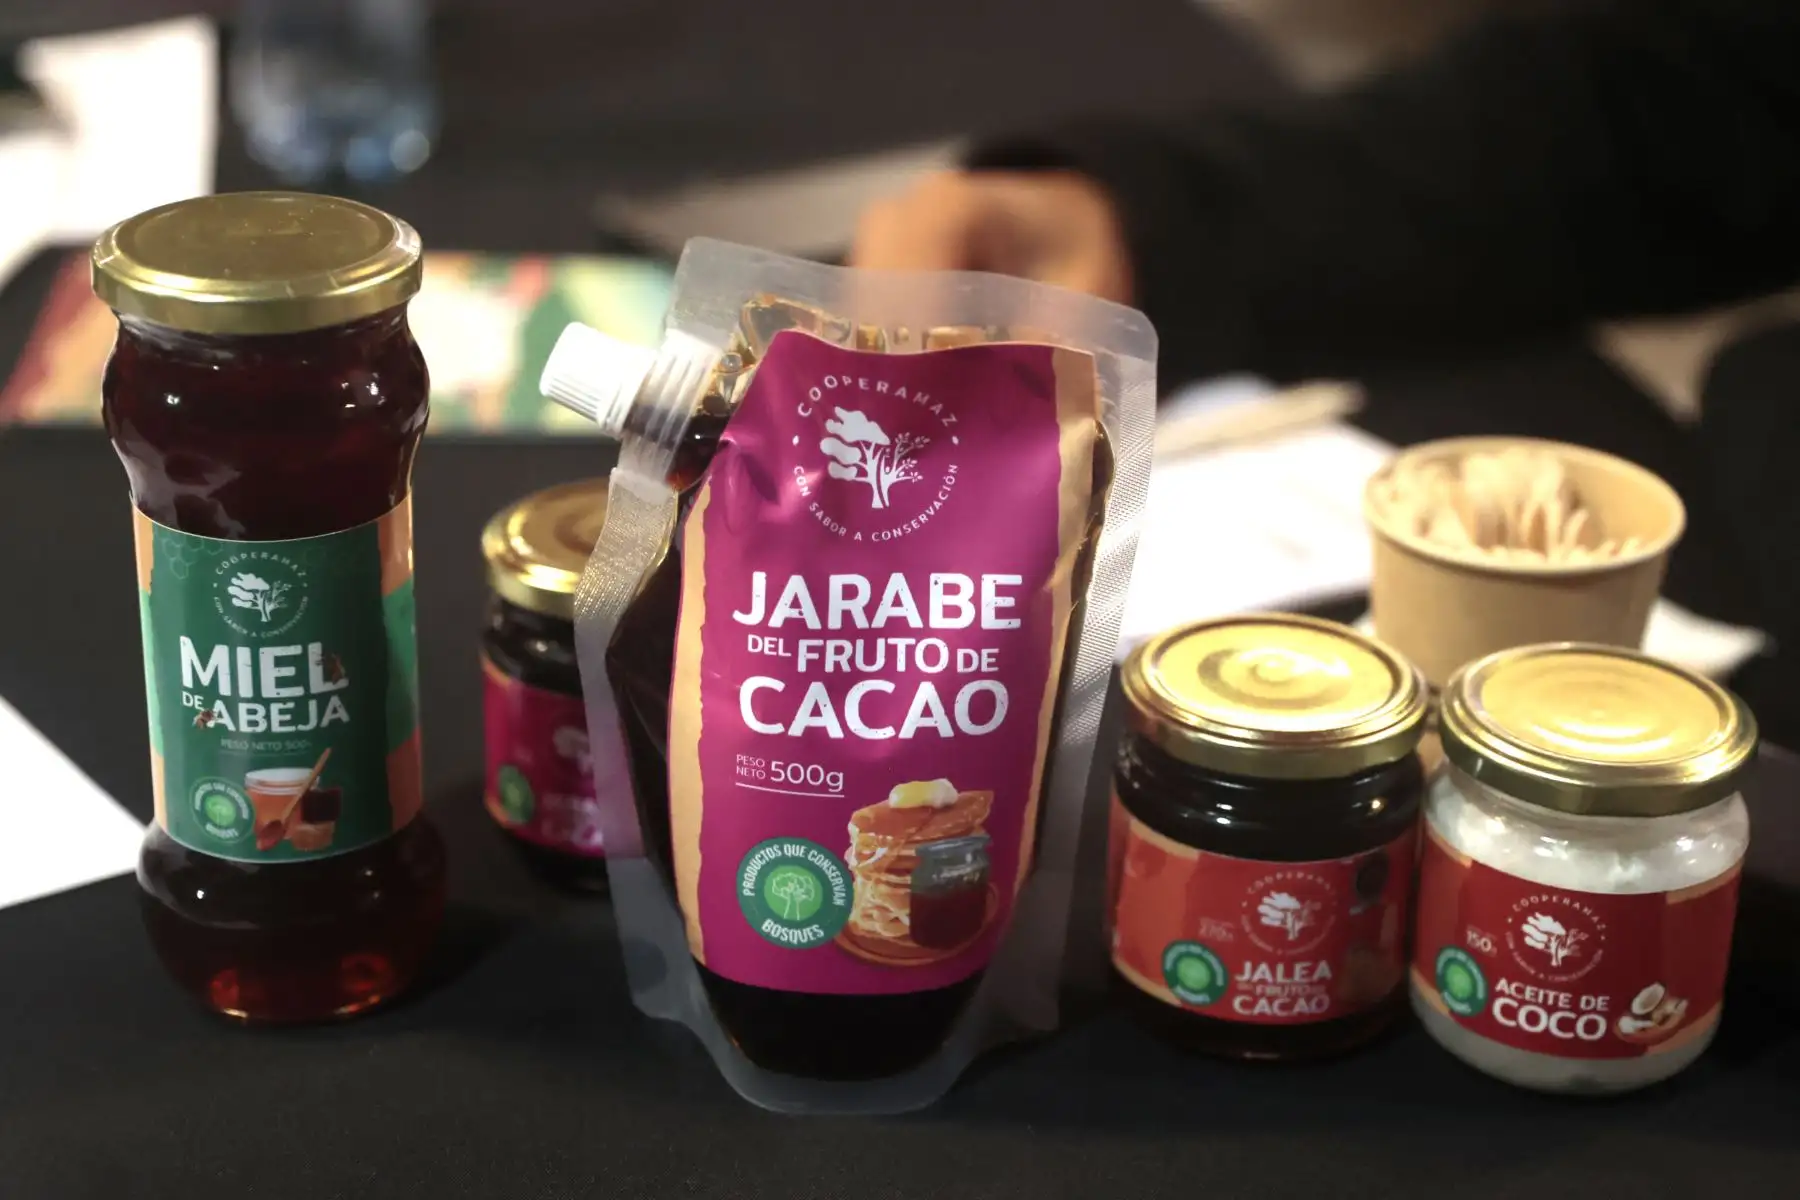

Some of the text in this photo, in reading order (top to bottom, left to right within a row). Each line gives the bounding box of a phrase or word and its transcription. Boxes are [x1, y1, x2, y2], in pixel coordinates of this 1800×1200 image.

[798, 374, 959, 428] COOPERAMAZ
[793, 463, 958, 542] CON SABOR A CONSERVACIÓN
[732, 571, 1023, 630] JARABE
[180, 636, 349, 698] MIEL
[747, 634, 1000, 673] DEL FRUTO DE
[183, 690, 204, 712] DE
[206, 695, 351, 734] ABEJA
[738, 675, 1009, 740] CACAO
[736, 754, 766, 768] PESO
[736, 765, 766, 780] NETO
[770, 760, 844, 792] 500g
[742, 844, 846, 906] PRODUCTOS QUE CONSERVAN
[761, 918, 825, 945] BOSQUES
[1235, 960, 1333, 983] JALEA
[1232, 994, 1331, 1017] CACAO
[1495, 977, 1610, 1012] ACEITE DE
[1491, 997, 1607, 1041] COCO
